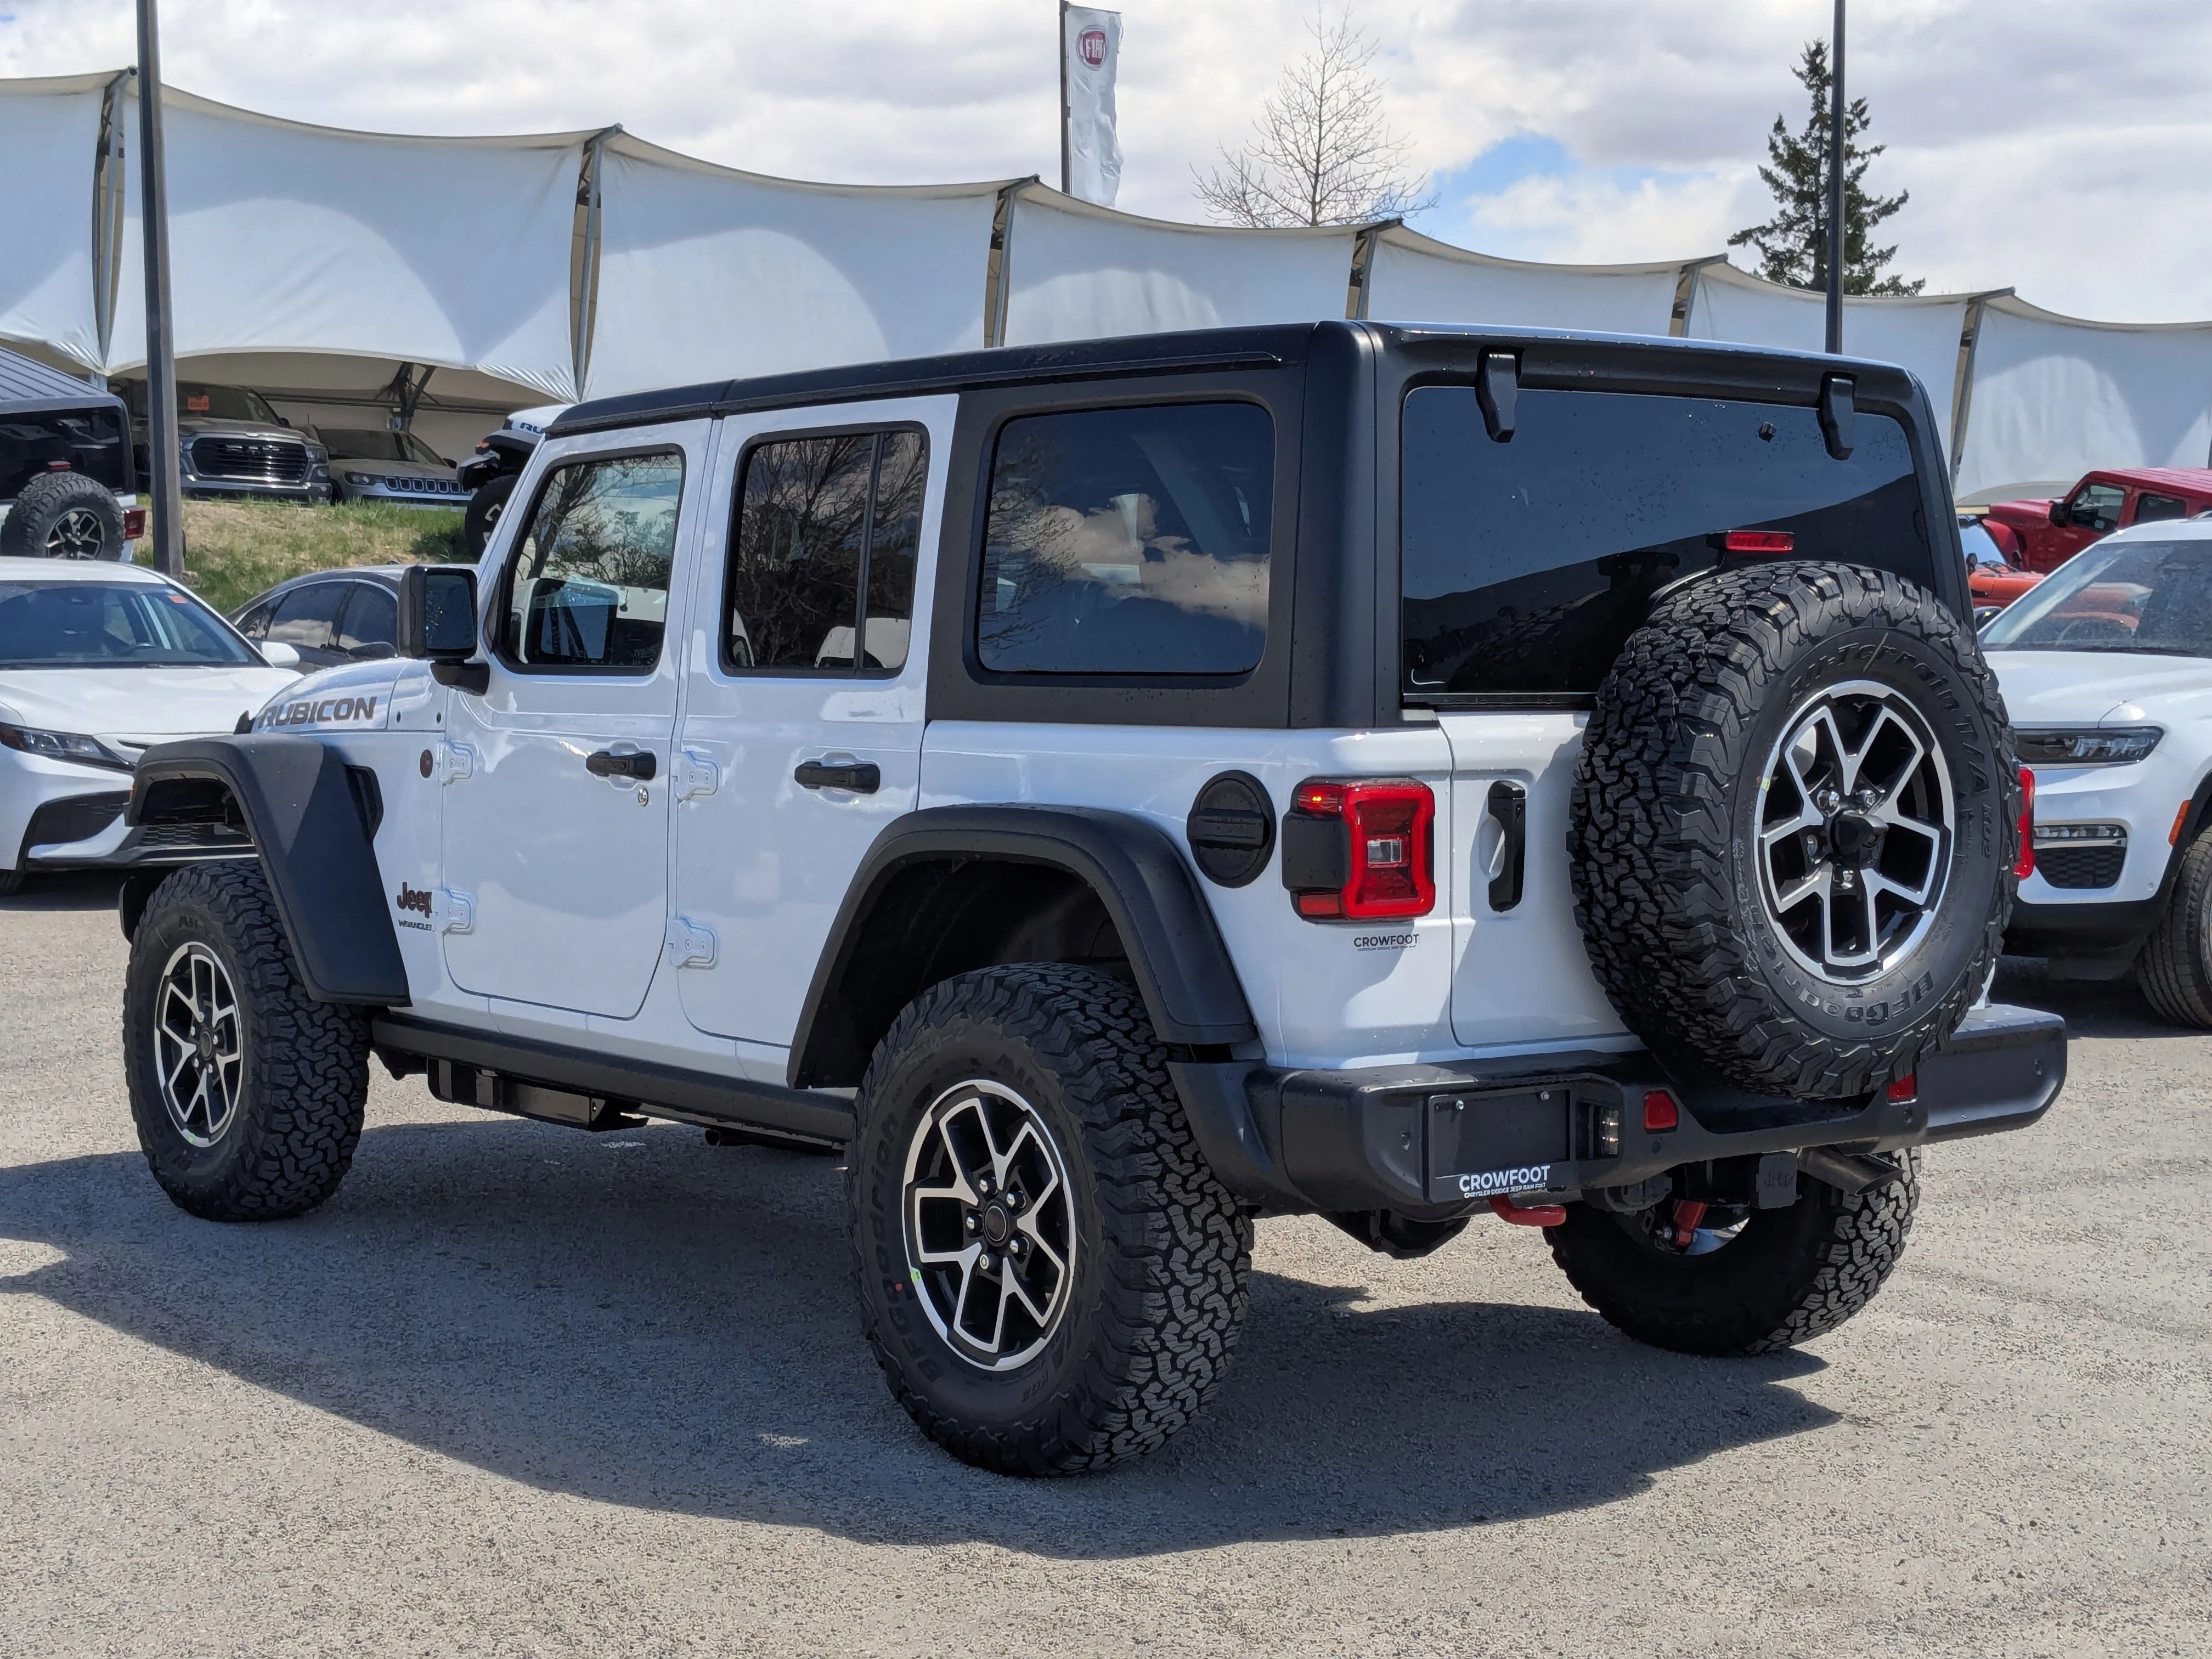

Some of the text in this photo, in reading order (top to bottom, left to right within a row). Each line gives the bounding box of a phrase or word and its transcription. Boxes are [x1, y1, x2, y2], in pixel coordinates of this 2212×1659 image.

[258, 696, 377, 729] RUBICON
[397, 882, 432, 918] Jeep
[1353, 934, 1419, 947] CROWFOOT
[1459, 1165, 1550, 1192] CROWFOOT
